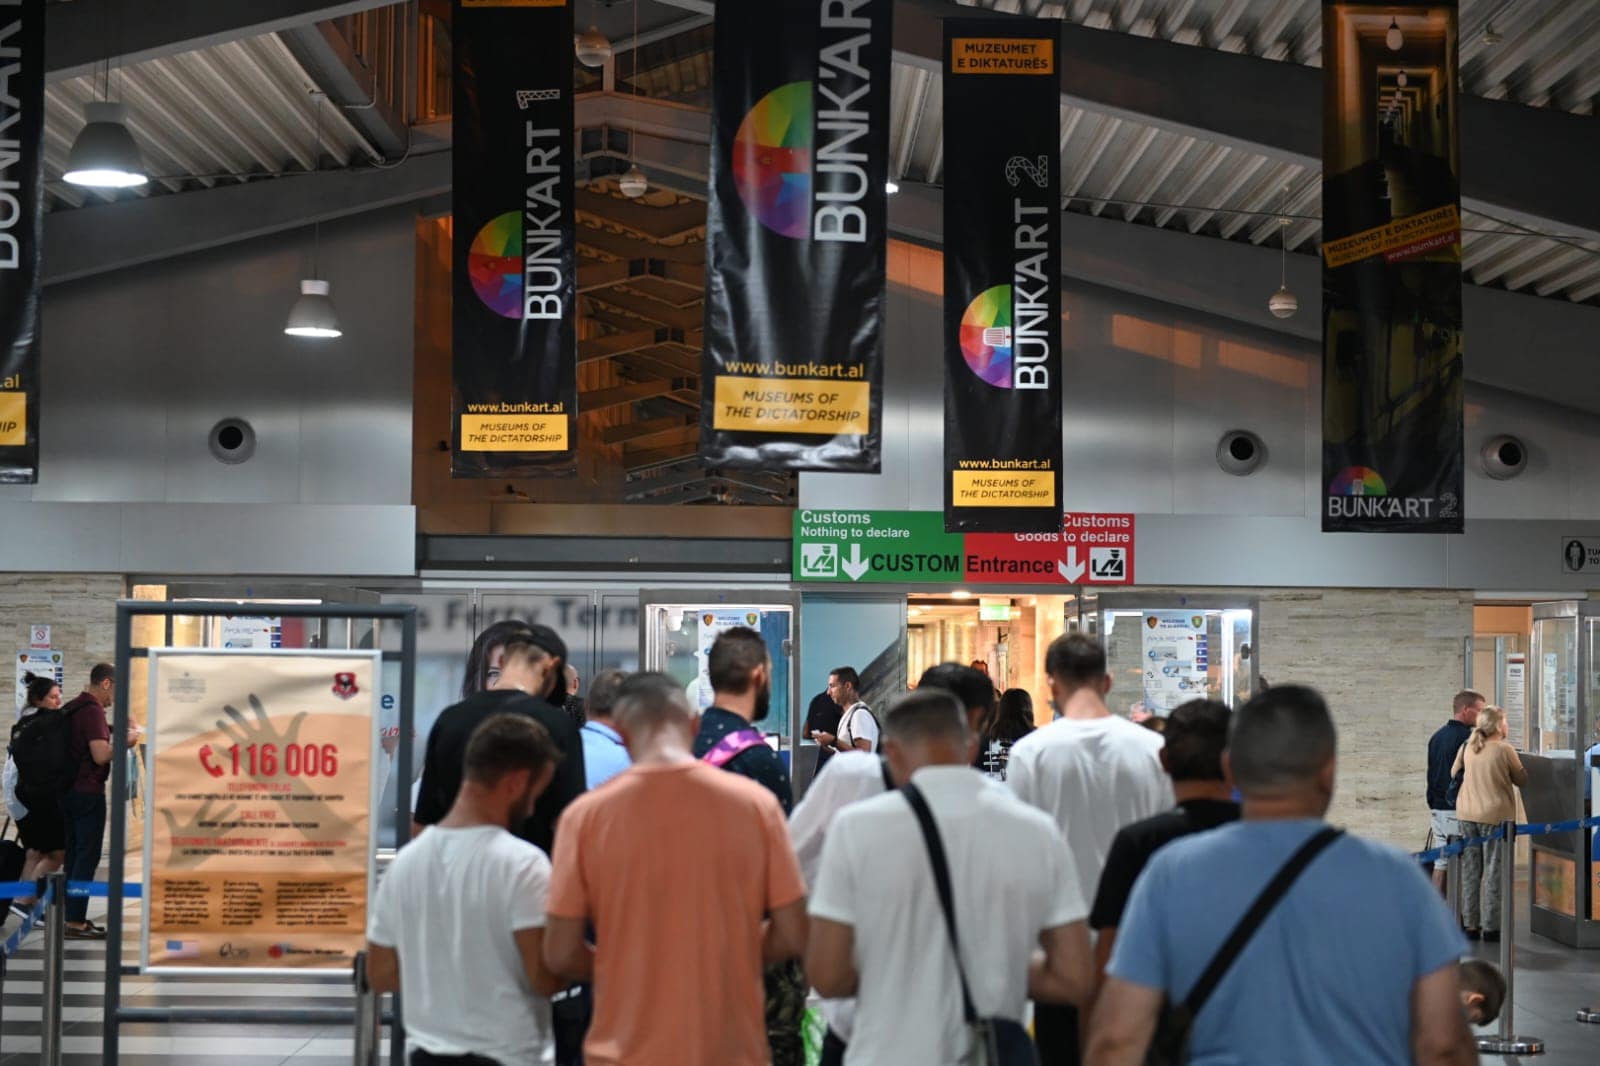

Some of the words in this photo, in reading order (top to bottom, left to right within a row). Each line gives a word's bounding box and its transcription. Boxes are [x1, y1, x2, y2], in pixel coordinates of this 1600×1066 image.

[965, 44, 1037, 54] MUZEUMET
[957, 59, 965, 68] E
[969, 57, 1049, 69] DIKTATURËS
[516, 89, 560, 109] 1
[1005, 155, 1048, 187] 2
[525, 120, 562, 319] BUNK'ART
[1014, 198, 1049, 390] BUNK'ART
[725, 361, 864, 378] www.bunkart.al
[743, 391, 814, 404] MUSEUMS
[818, 393, 839, 404] OF
[467, 402, 563, 413] www.bunkart.al
[725, 406, 753, 418] THE
[756, 408, 860, 423] DICTATORSHIP
[480, 423, 529, 432] MUSEUMS
[532, 423, 547, 432] OF
[468, 434, 488, 443] THE
[490, 434, 562, 443] DICTATORSHIP
[959, 458, 1051, 469] www.bunkart.al
[971, 479, 1019, 488] MUSEUMS
[1021, 479, 1036, 488] OF
[960, 490, 977, 499] THE
[980, 490, 1049, 499] DICTATORSHIP
[1328, 496, 1434, 518] BUNK'ART
[1439, 492, 1458, 518] 2
[801, 511, 871, 524] Customs
[1063, 513, 1131, 528] Customs
[801, 526, 848, 540] Nothing
[851, 527, 863, 537] to
[866, 527, 911, 538] declare
[1063, 531, 1077, 542] to
[1080, 531, 1130, 543] declare
[871, 553, 960, 572] CUSTOM
[967, 555, 1055, 573] Entrance
[228, 743, 278, 777] 116
[285, 743, 338, 777] 006
